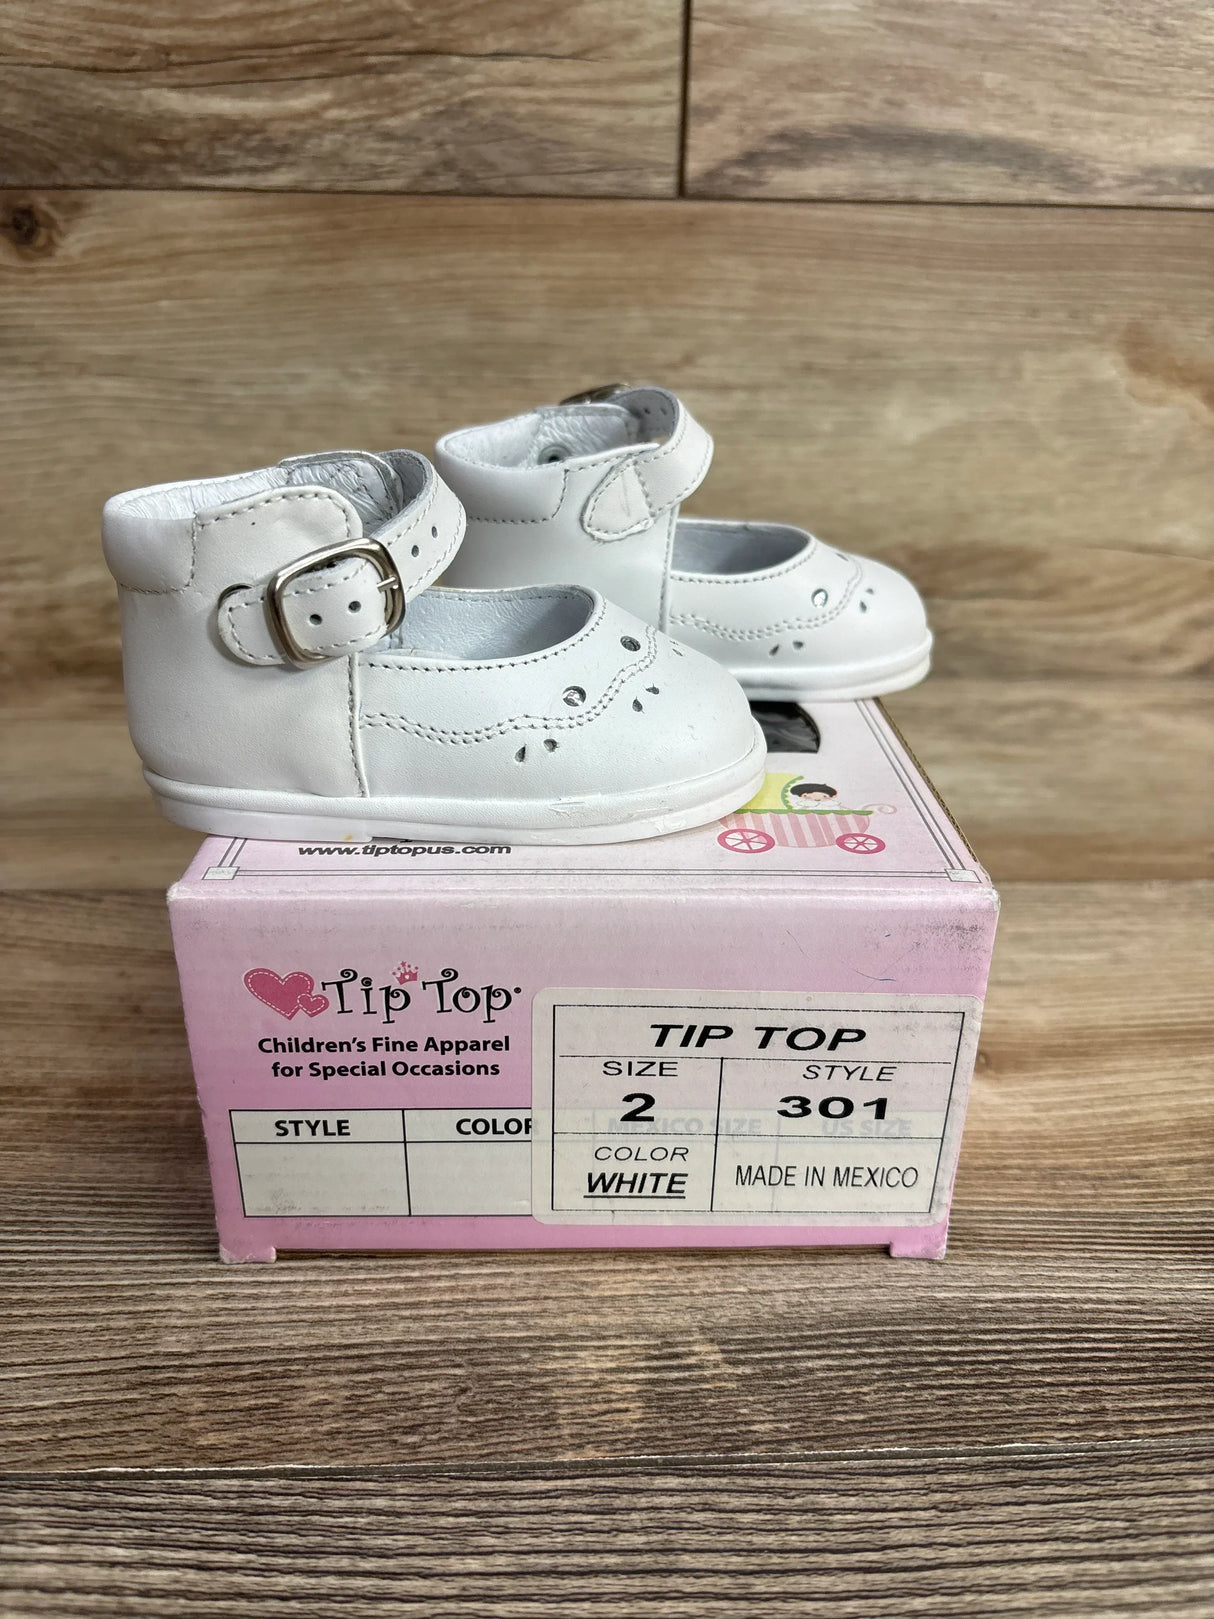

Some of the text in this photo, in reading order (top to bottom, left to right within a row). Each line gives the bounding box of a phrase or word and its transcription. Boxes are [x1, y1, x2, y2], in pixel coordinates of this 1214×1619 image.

[298, 844, 512, 857] www.tiptopus.com
[321, 968, 411, 1024] Tip
[258, 1036, 510, 1055] Children's Fine Apparel
[650, 1024, 867, 1051] TIP TOP
[271, 1060, 500, 1080] for Special Occasions
[602, 1061, 679, 1077] SIZE
[802, 1064, 897, 1082] STYLE
[620, 1092, 656, 1122] 2
[777, 1095, 888, 1120] 301
[274, 1119, 351, 1136] STYLE
[594, 1146, 690, 1162] COLOR
[587, 1172, 689, 1194] WHITE
[735, 1165, 919, 1188] MADE IN MEXICO
